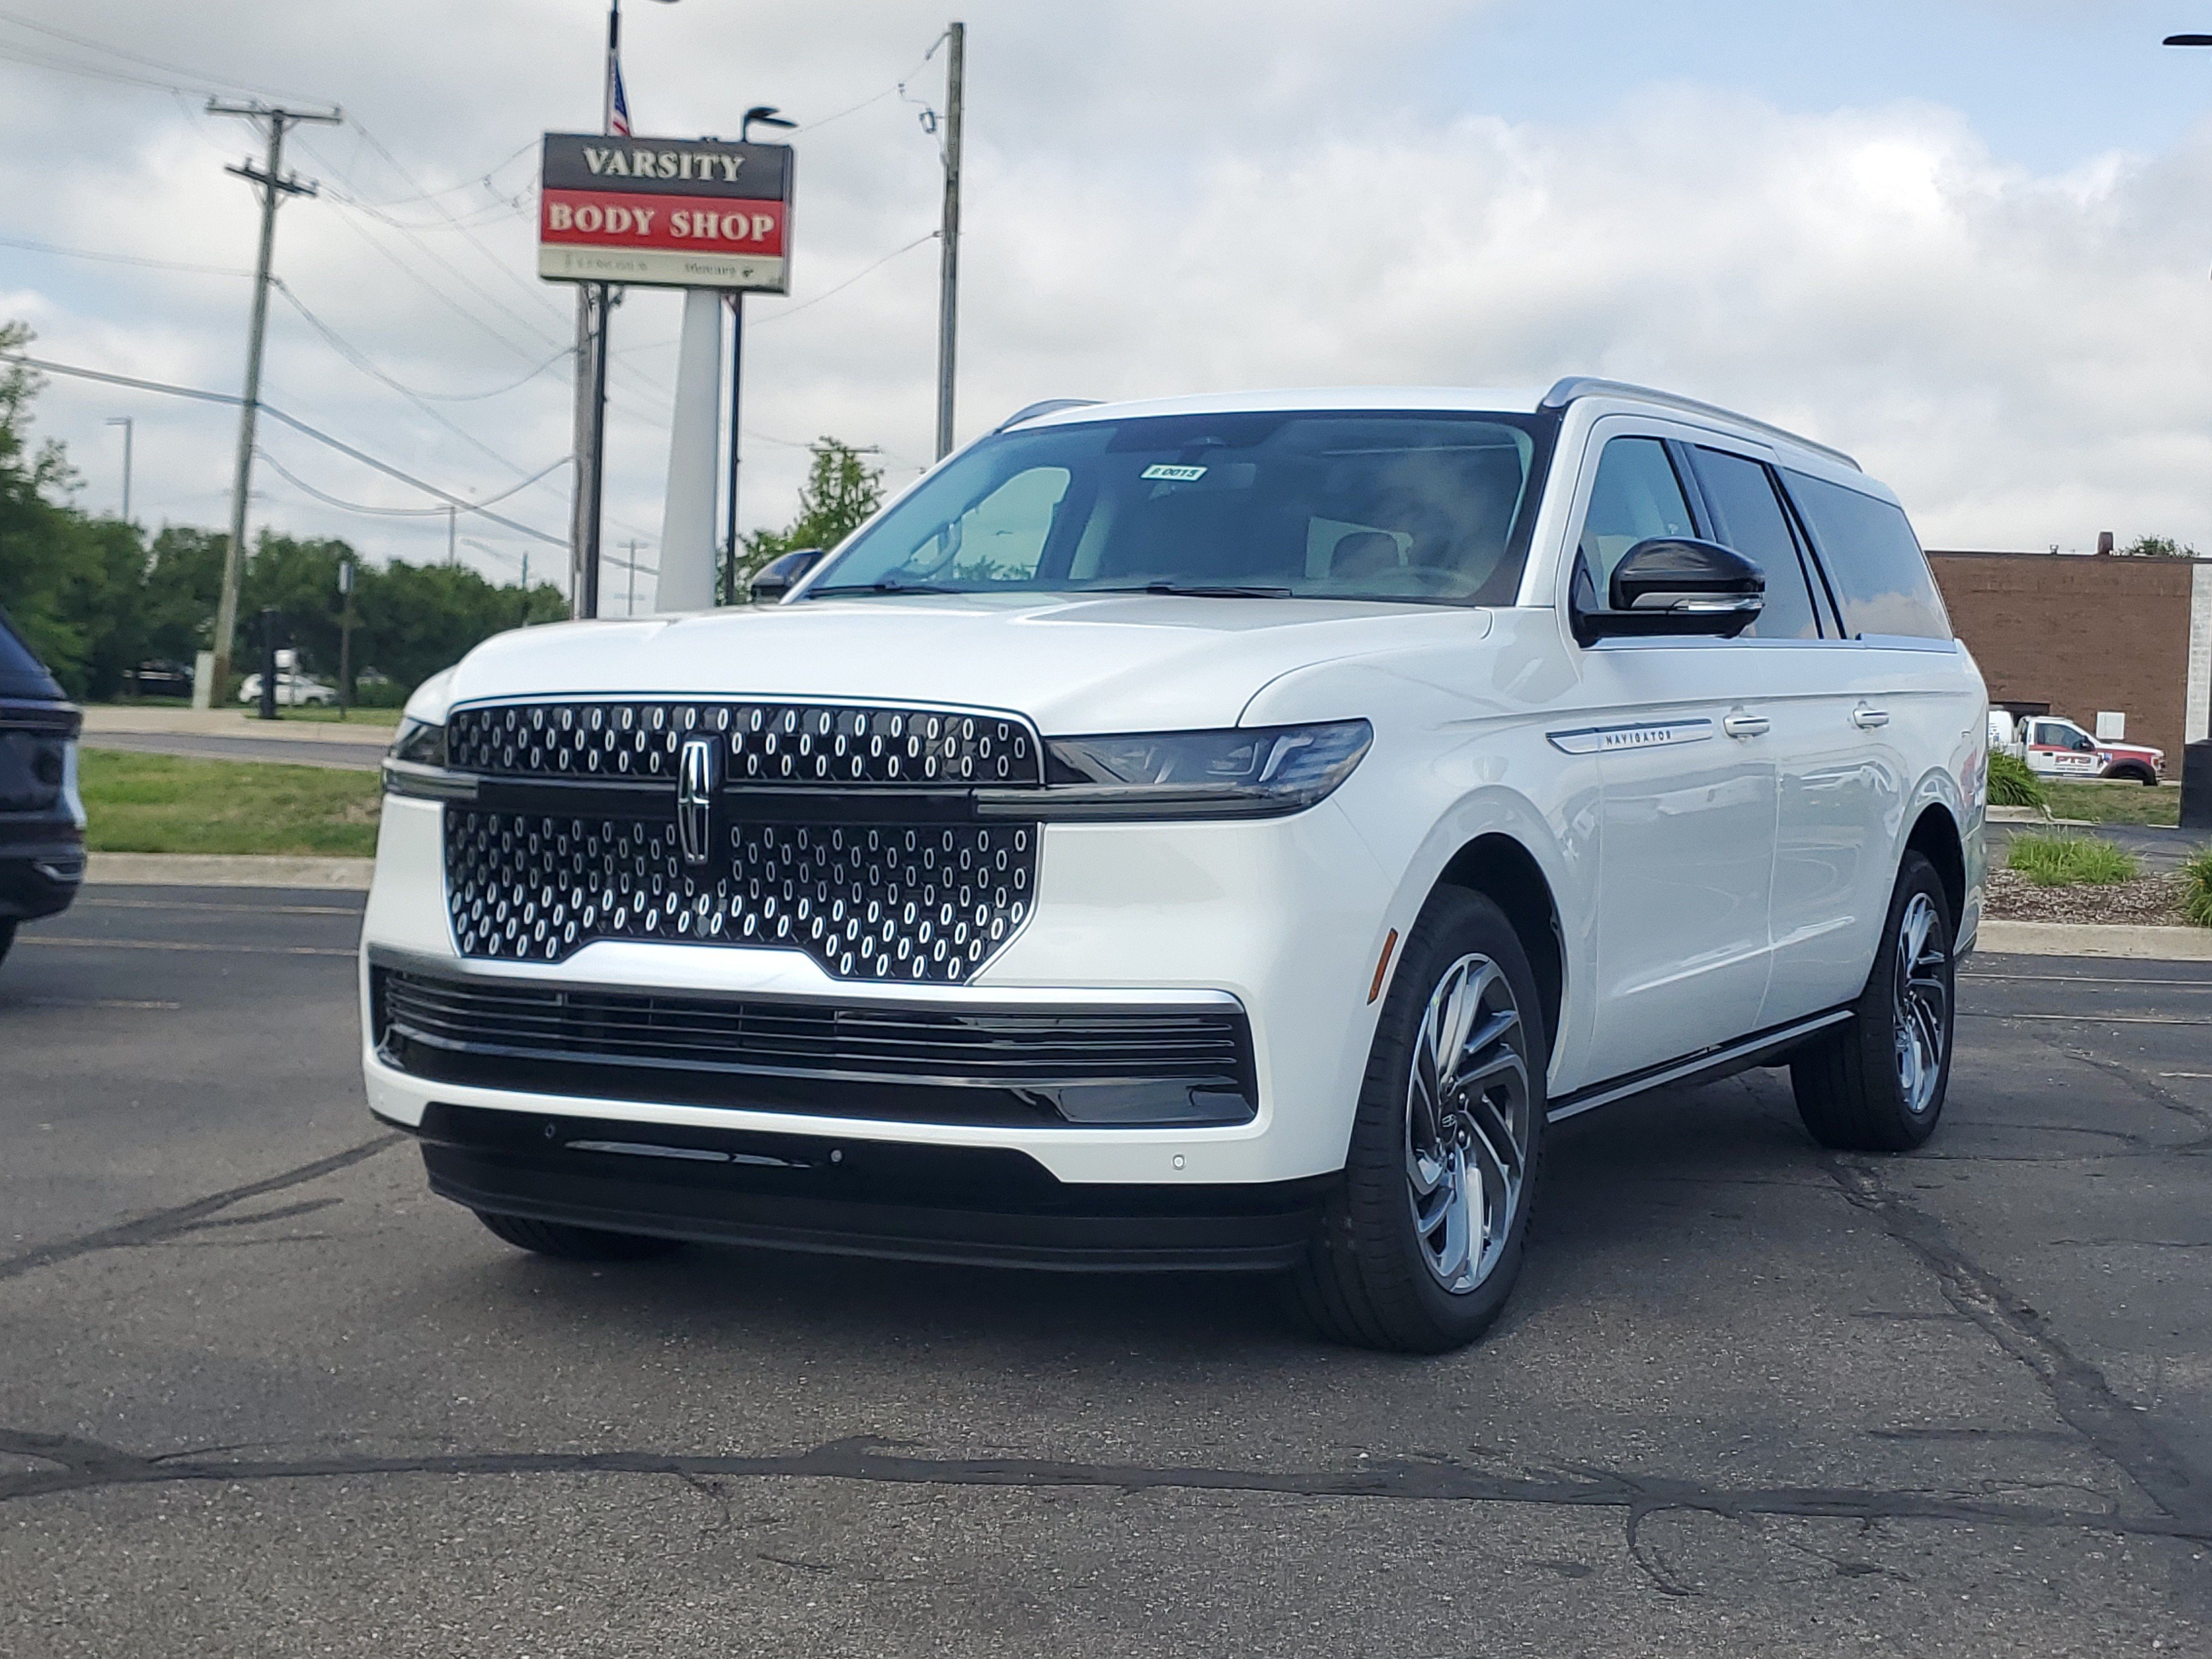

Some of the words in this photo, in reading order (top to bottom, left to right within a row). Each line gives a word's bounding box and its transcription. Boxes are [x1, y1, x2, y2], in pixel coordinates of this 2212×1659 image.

[583, 145, 745, 182] VARSITY
[549, 202, 656, 236] BODY
[670, 209, 774, 241] SHOP
[1606, 730, 1672, 745] NAVIGATOR
